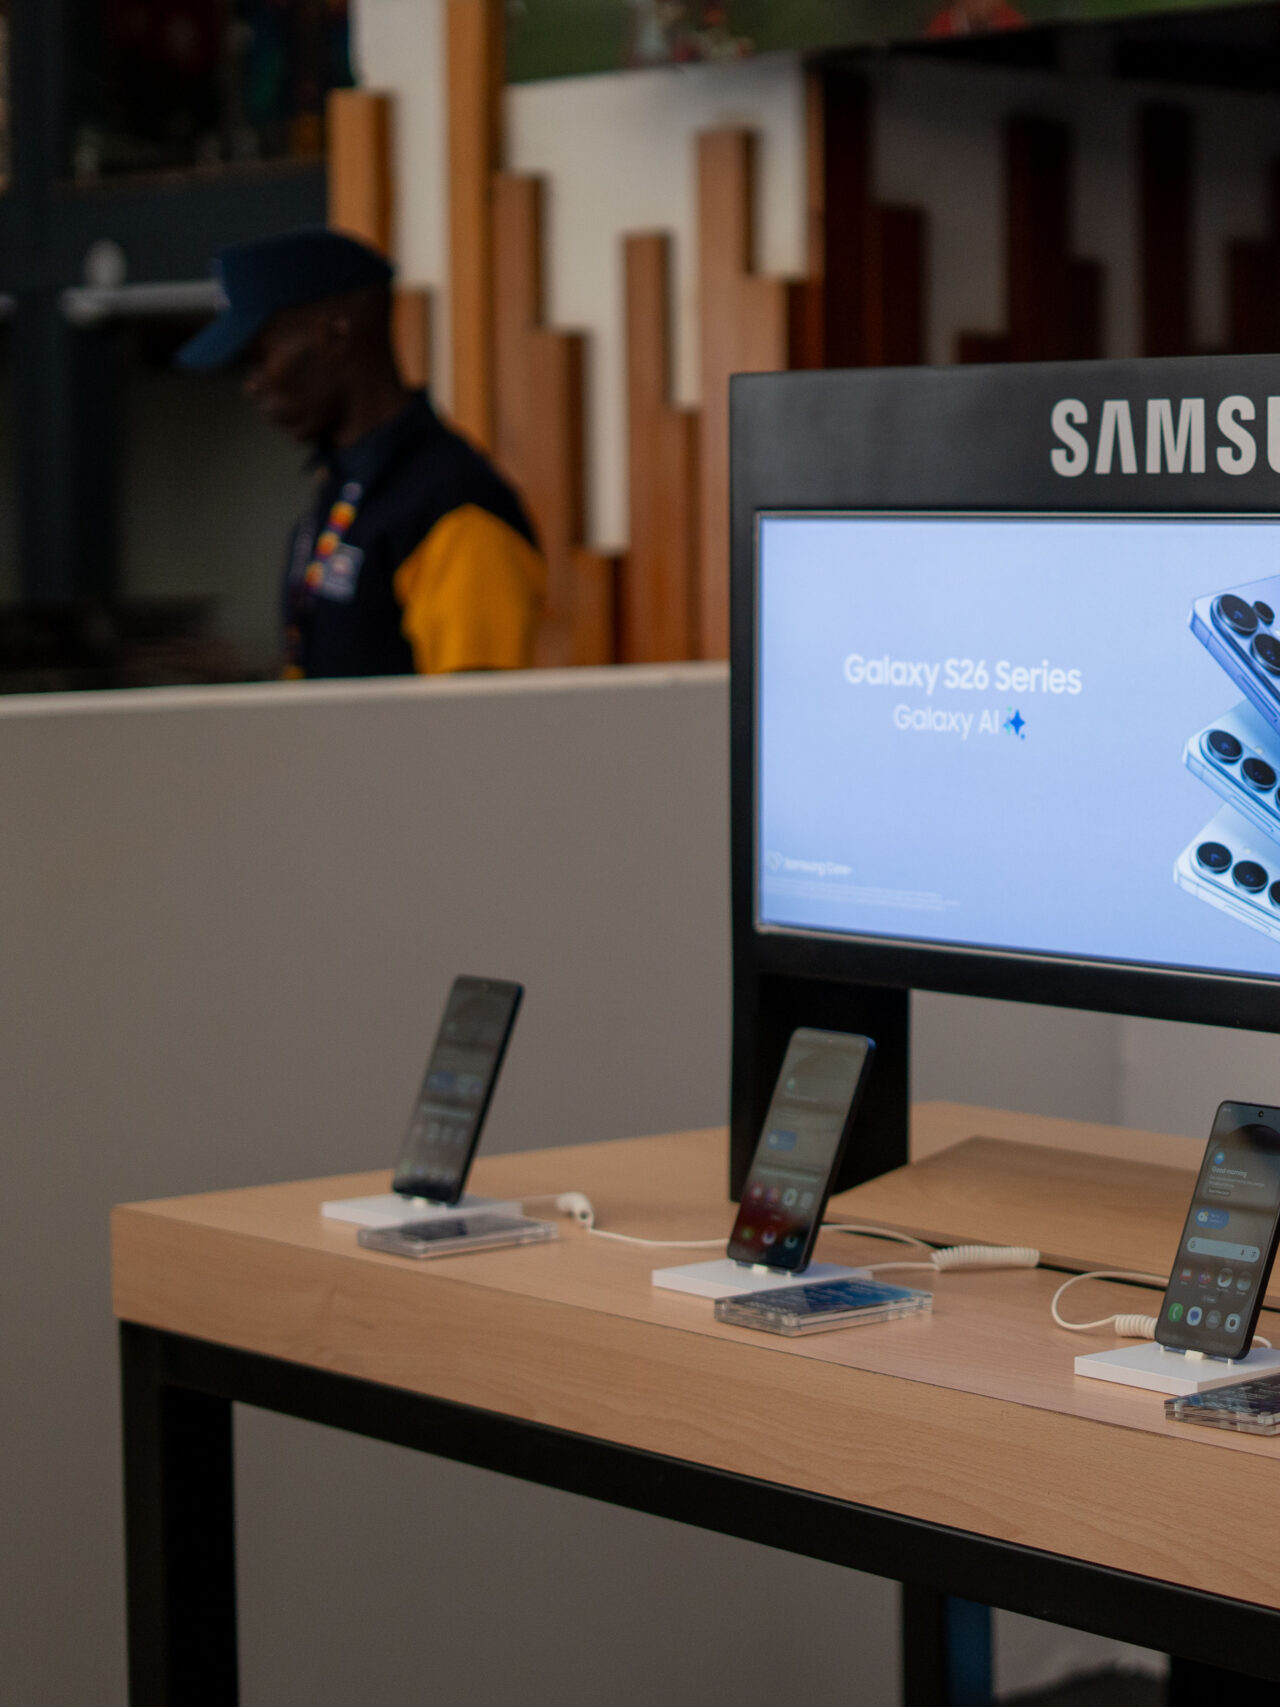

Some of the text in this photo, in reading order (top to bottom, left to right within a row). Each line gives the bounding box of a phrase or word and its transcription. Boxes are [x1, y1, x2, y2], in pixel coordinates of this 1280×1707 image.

[844, 653, 1083, 696] Galaxy S26 Series
[893, 704, 1000, 741] Galaxy AI
